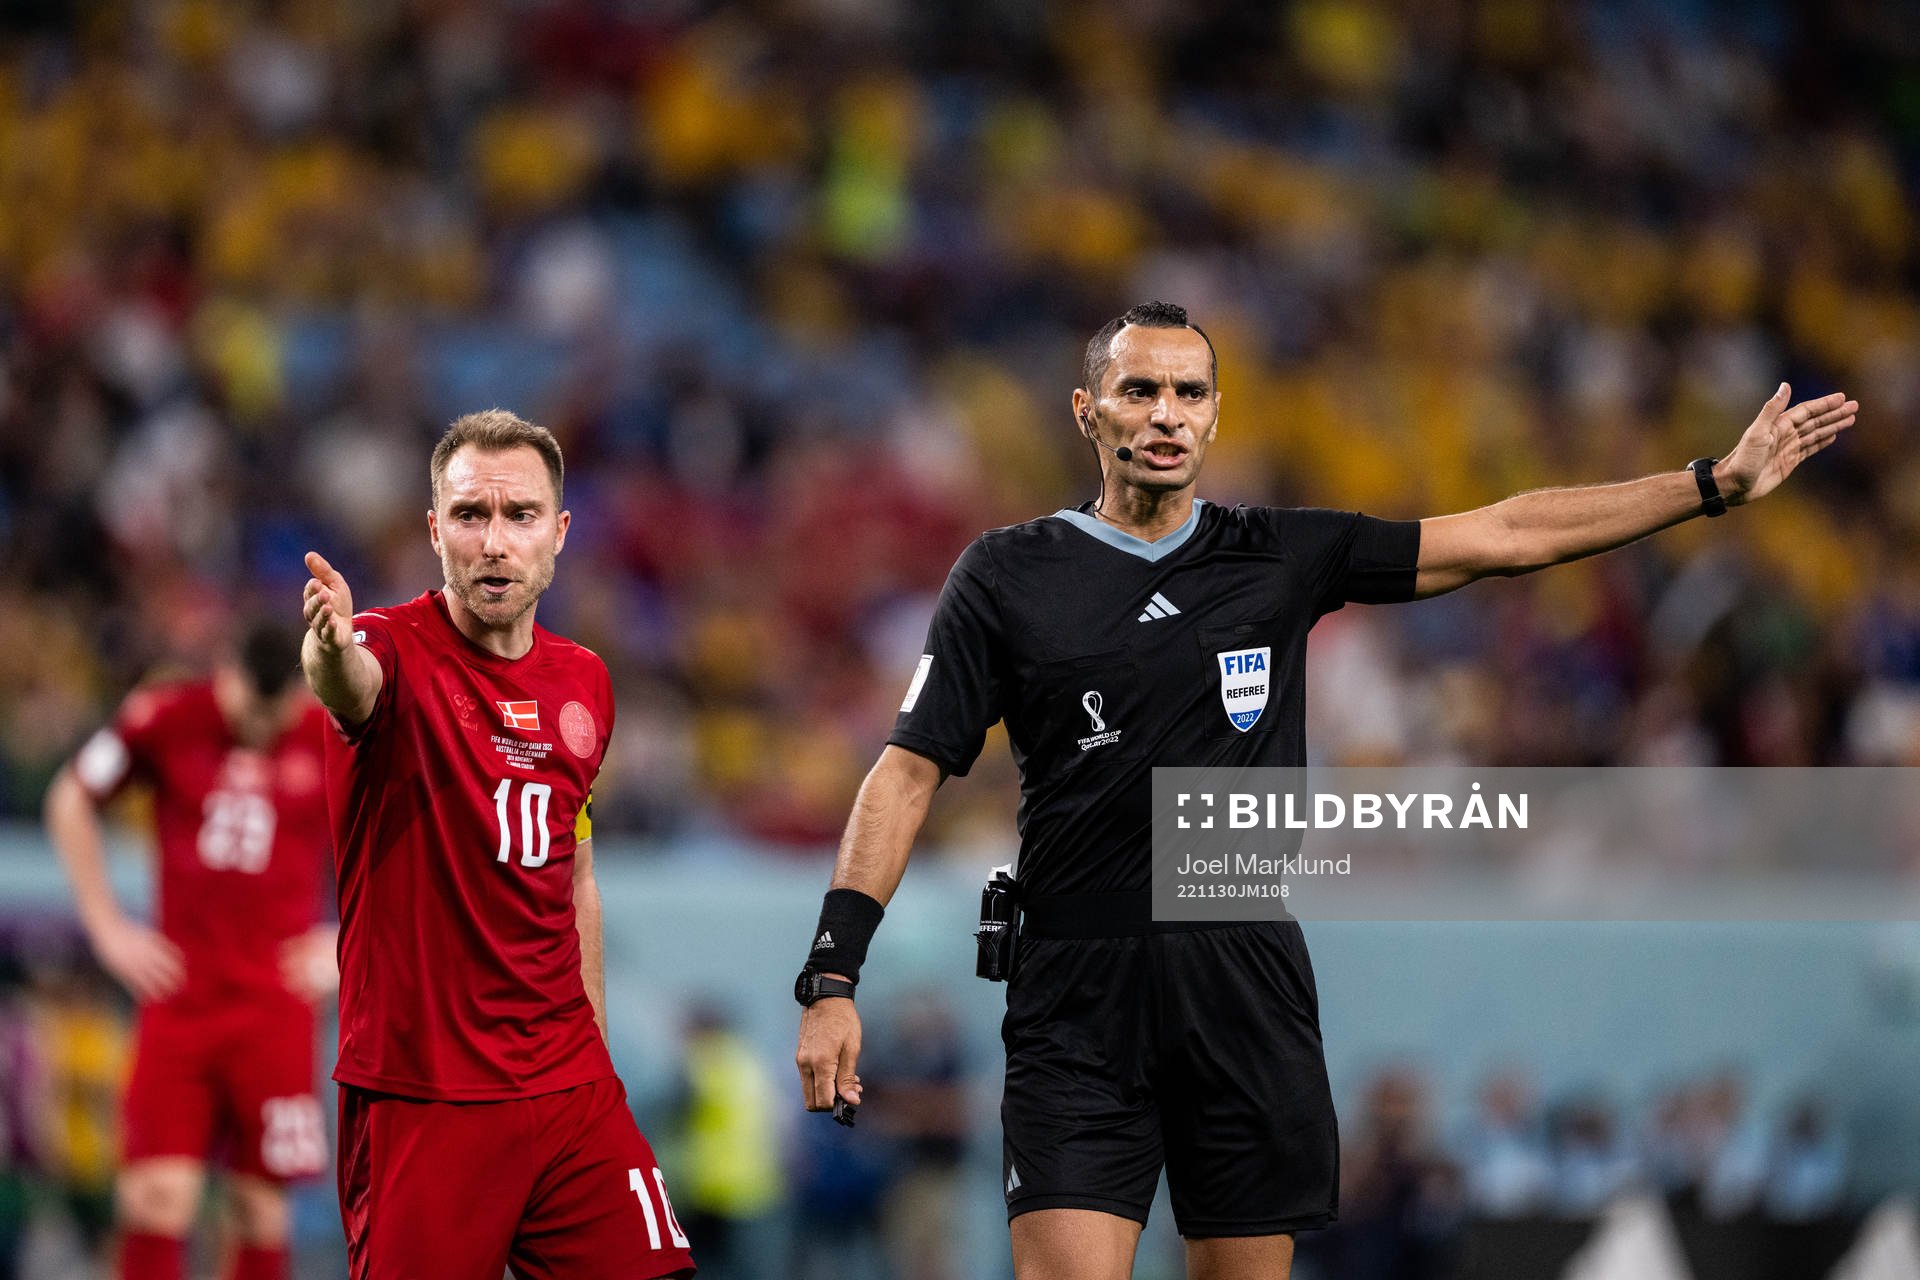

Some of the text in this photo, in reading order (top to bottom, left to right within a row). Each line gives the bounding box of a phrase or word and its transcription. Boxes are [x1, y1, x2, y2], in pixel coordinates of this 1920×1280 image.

[1224, 653, 1266, 676] FIFA
[1226, 684, 1266, 700] REFEREE
[1236, 712, 1255, 724] 2022
[490, 735, 553, 751] FIFA WORLD CUP QATAR 2022
[1077, 737, 1090, 746] FIFA
[1090, 732, 1110, 742] WORLD
[495, 745, 519, 756] AUSTRALIA
[525, 750, 548, 759] DENMARK
[493, 778, 552, 868] 10
[628, 1167, 691, 1250] 10
